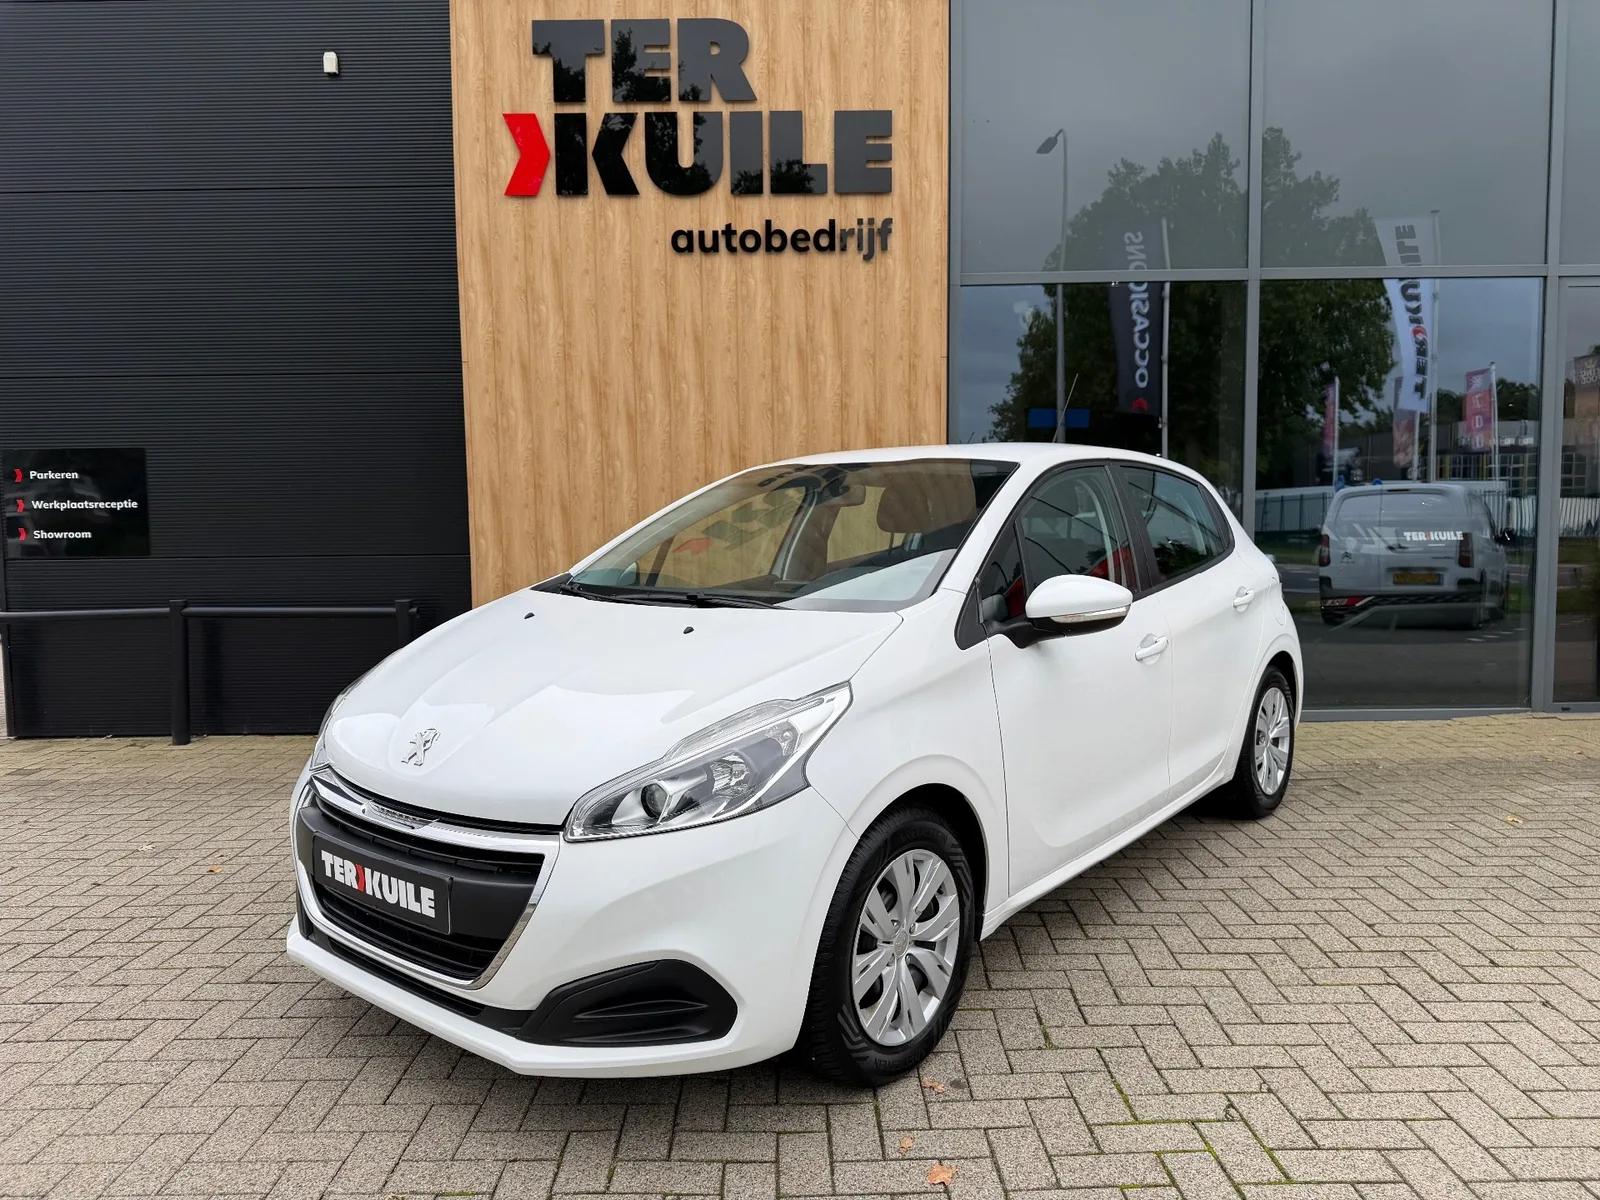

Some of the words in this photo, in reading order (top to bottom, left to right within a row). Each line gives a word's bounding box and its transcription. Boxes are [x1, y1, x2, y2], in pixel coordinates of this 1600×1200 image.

[531, 18, 757, 103] TER
[554, 110, 893, 196] KUILE
[671, 218, 893, 261] autobedrijf
[29, 470, 79, 480] Parkeren
[31, 499, 138, 511] Werkplaatsreceptie
[33, 530, 92, 539] Showroom
[1403, 531, 1427, 542] TER
[1430, 531, 1464, 541] KUILE
[321, 850, 358, 890] TER
[364, 867, 436, 918] KUILE
